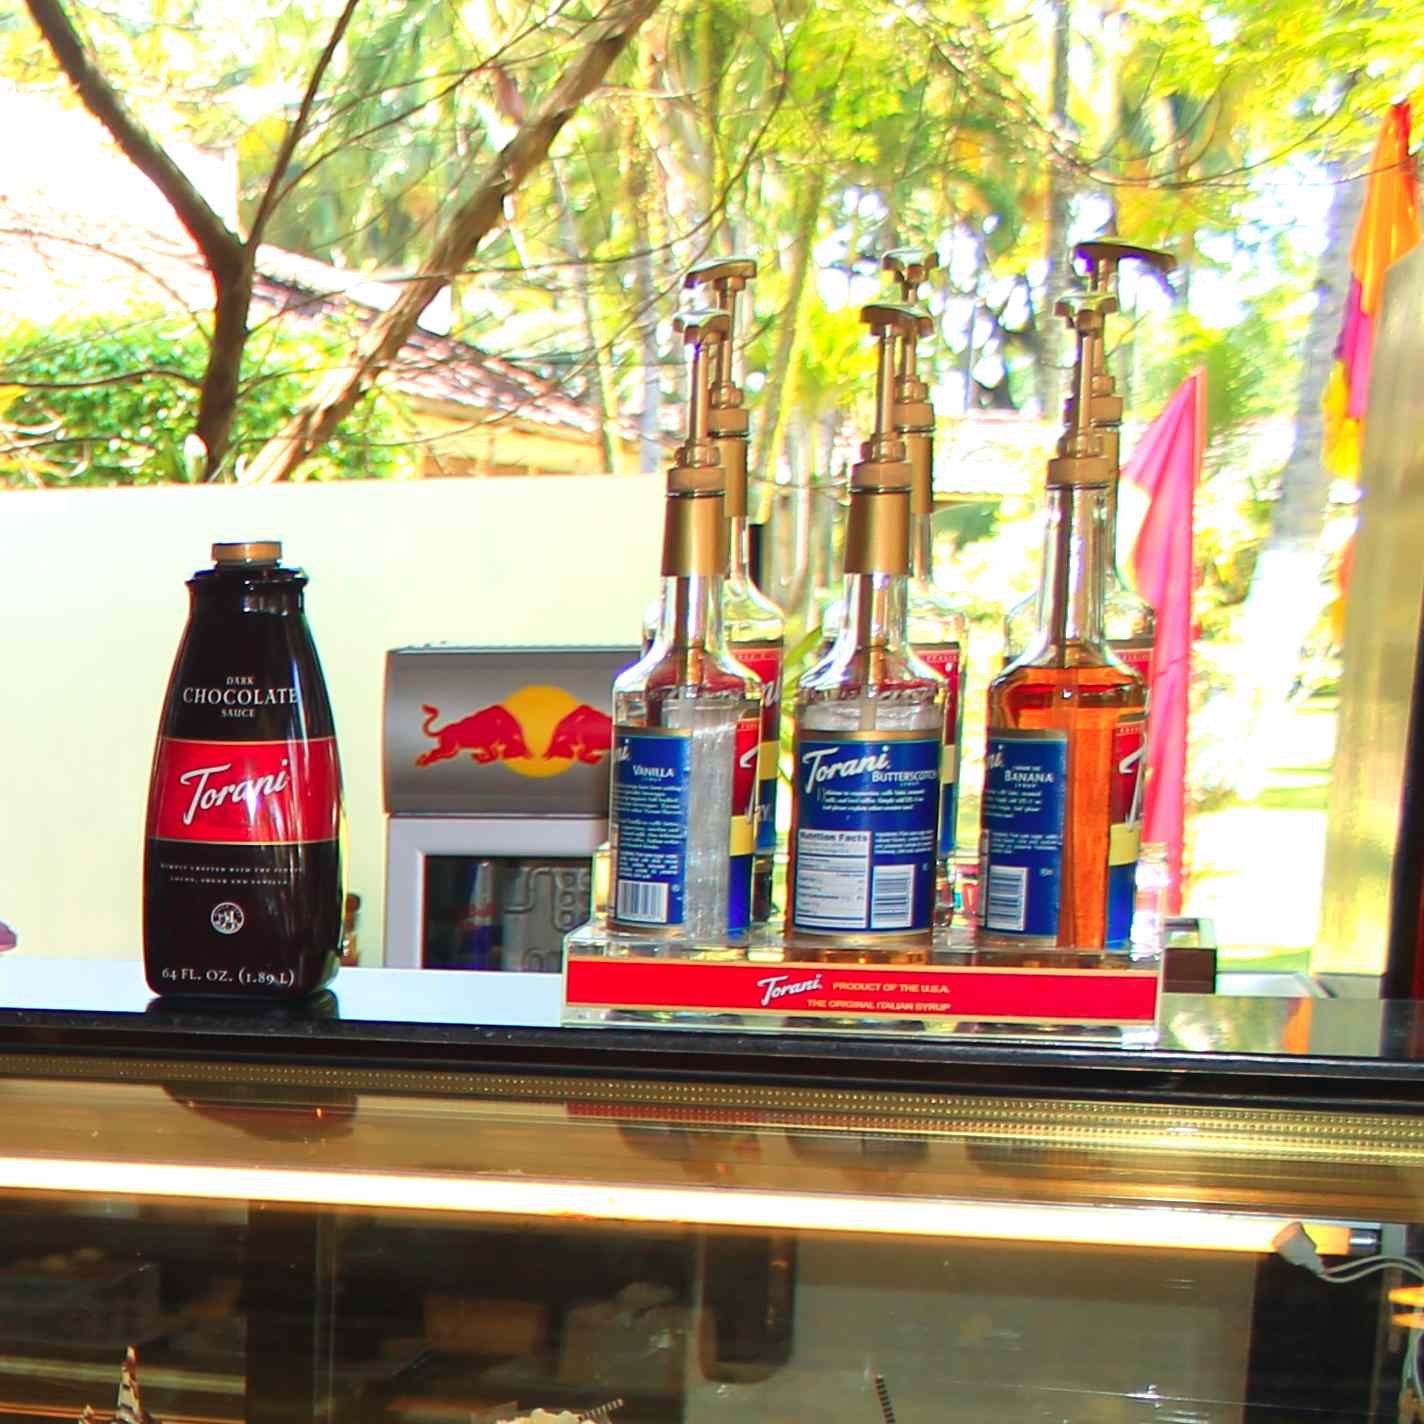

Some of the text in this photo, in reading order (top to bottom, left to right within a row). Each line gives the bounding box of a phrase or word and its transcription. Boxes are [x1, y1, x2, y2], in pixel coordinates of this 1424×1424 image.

[226, 676, 254, 686] DARK
[183, 687, 298, 705] CHOCOLATE
[221, 708, 255, 718] SAUCE
[633, 765, 674, 778] VANILLA
[802, 745, 891, 794] Torani
[1004, 770, 1054, 783] BANANA
[180, 758, 290, 825] Torani
[162, 967, 177, 981] 64
[181, 968, 201, 980] FL.
[206, 969, 233, 982] OZ.
[757, 974, 823, 1006] Torani
[832, 982, 881, 991] PRODUCT
[883, 982, 898, 992] OF
[901, 983, 919, 993] THE
[808, 999, 951, 1011] THE ORIGINAL ITALIAN SYRUP
